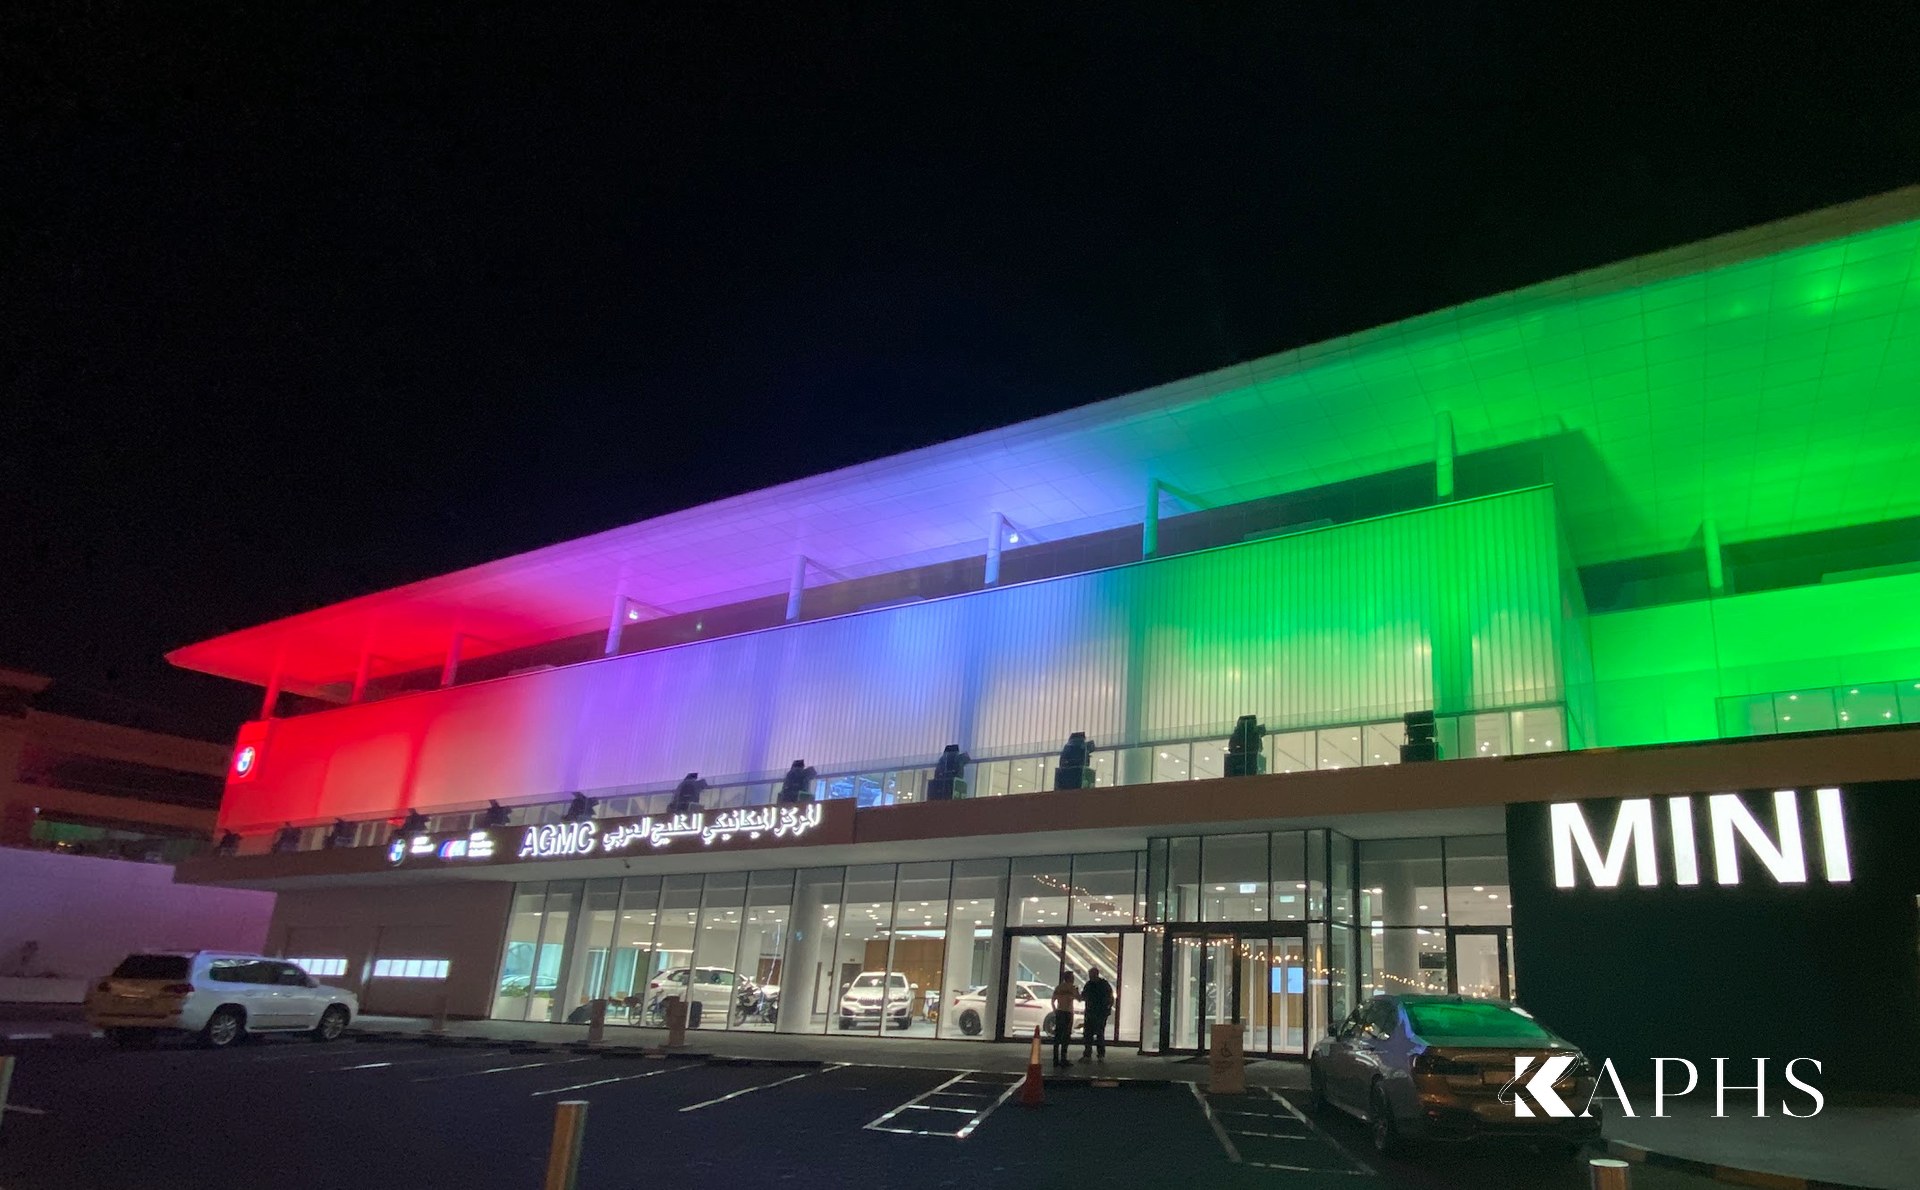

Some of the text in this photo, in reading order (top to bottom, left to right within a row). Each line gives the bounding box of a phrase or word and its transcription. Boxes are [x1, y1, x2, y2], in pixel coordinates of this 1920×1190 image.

[519, 821, 595, 857] AGMC
[602, 804, 822, 851] المركز الميكانيكي للخليج العربي
[1550, 788, 1852, 888] MINI
